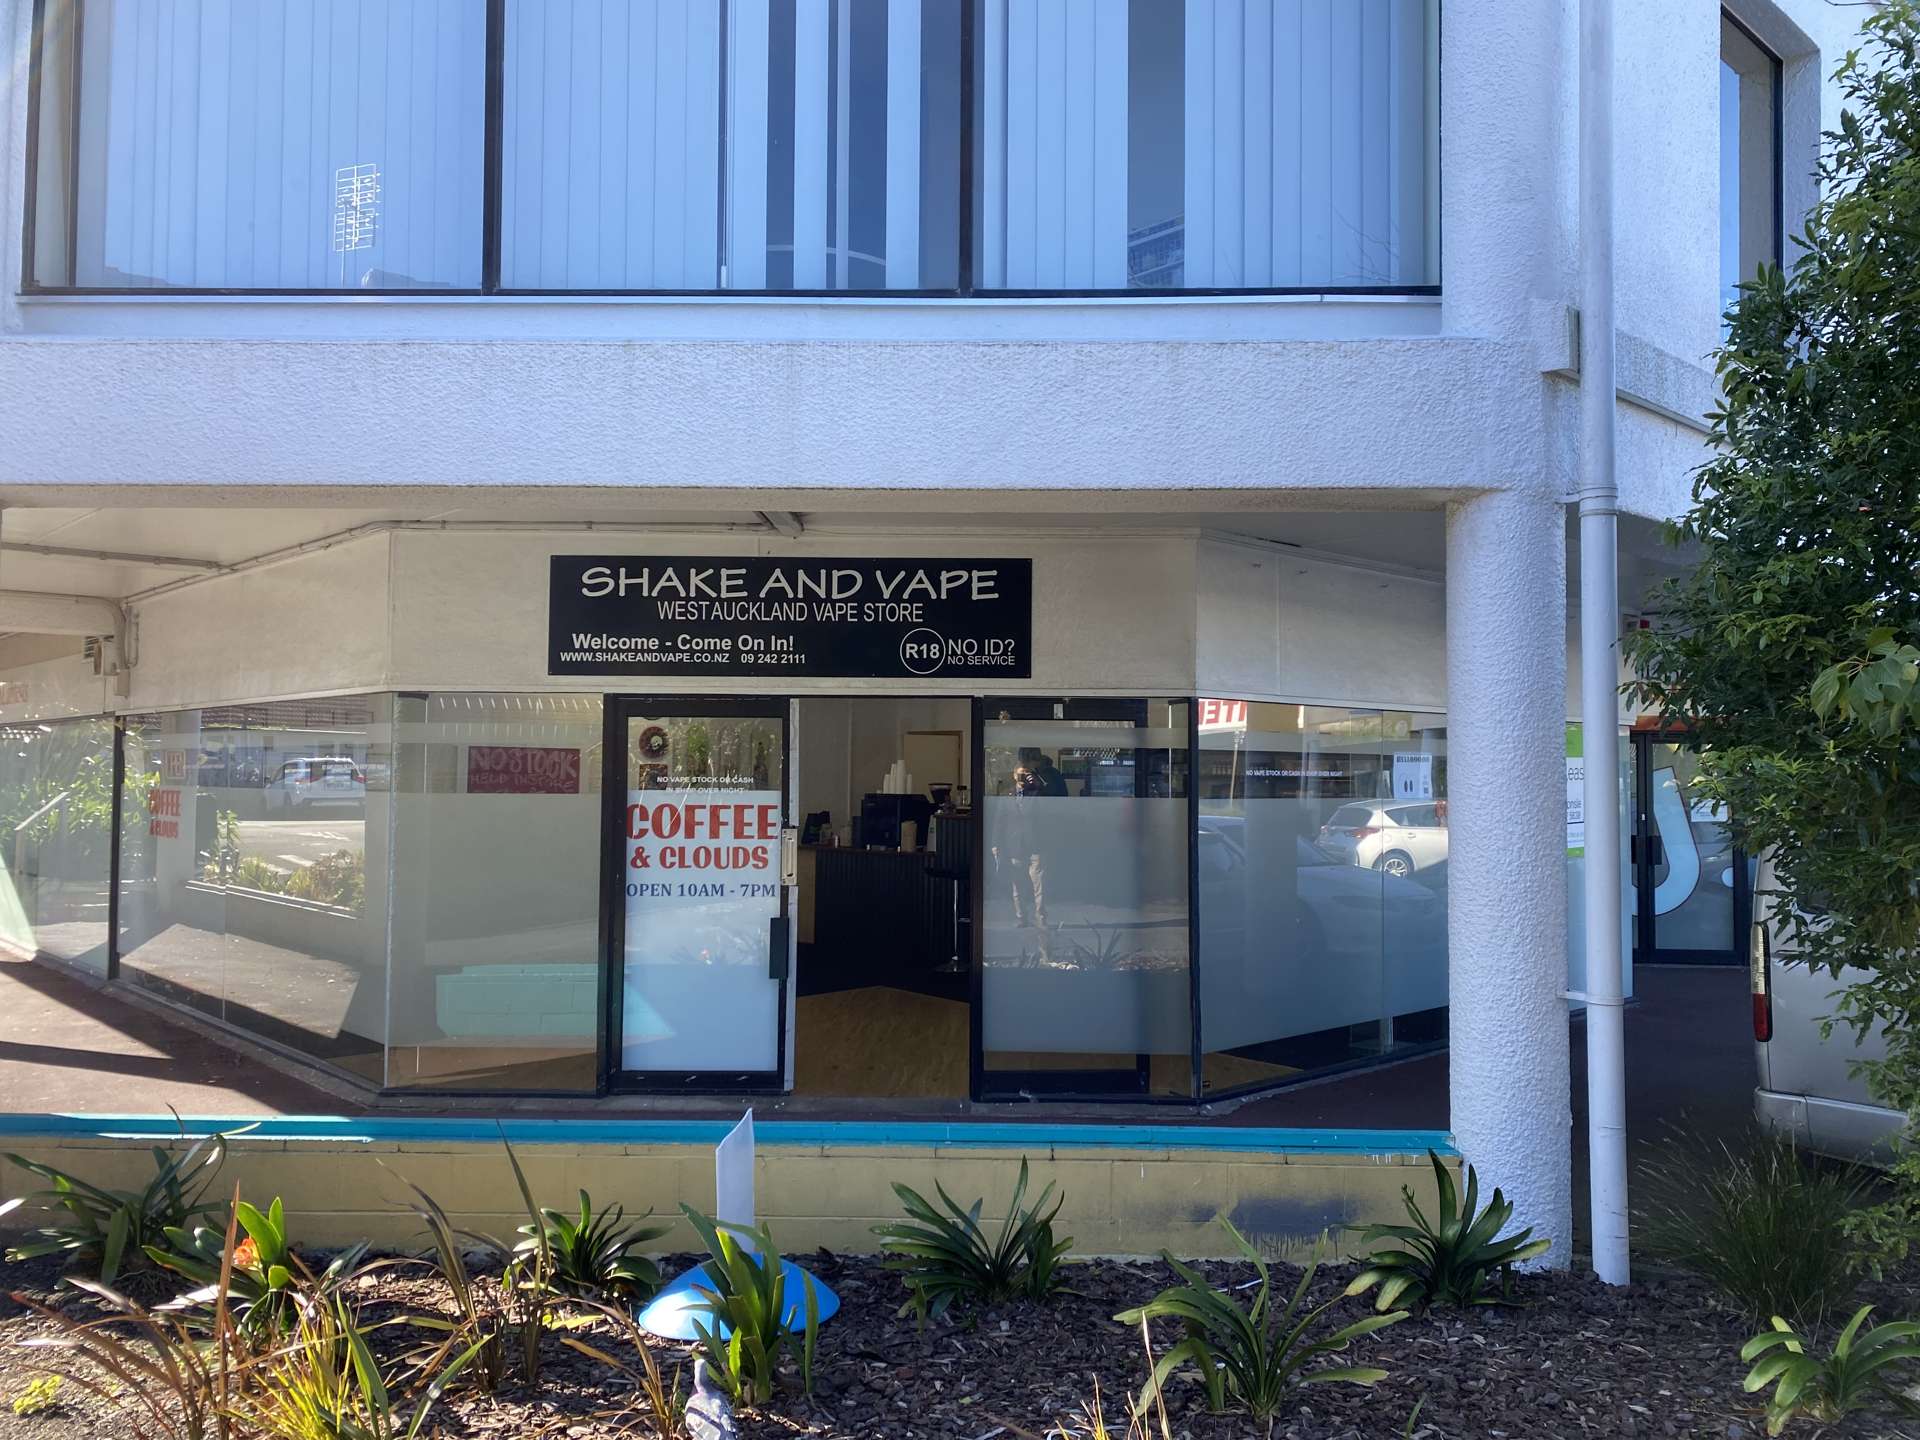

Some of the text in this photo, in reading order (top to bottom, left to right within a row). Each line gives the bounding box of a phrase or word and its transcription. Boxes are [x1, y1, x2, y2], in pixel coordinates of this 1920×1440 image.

[582, 567, 999, 600] SHAKE AND VAPE
[657, 601, 923, 622] WEST AUCKLAND VAPE STORE
[572, 633, 659, 649] Welcome
[677, 634, 732, 650] Come
[738, 635, 764, 651] On
[771, 635, 794, 651] In!
[948, 639, 1015, 655] NO ID?
[560, 652, 806, 664] WWW.SHAKEANDVAPE.CO.NZ 09 242 2111
[905, 643, 940, 659] R18
[948, 656, 1016, 666] NO SERVICE
[626, 803, 778, 839] COFFEE
[630, 846, 769, 870] & CLOUDS
[626, 883, 672, 897] OPEN
[678, 883, 725, 897] 10AM
[740, 883, 776, 897] 7PM
